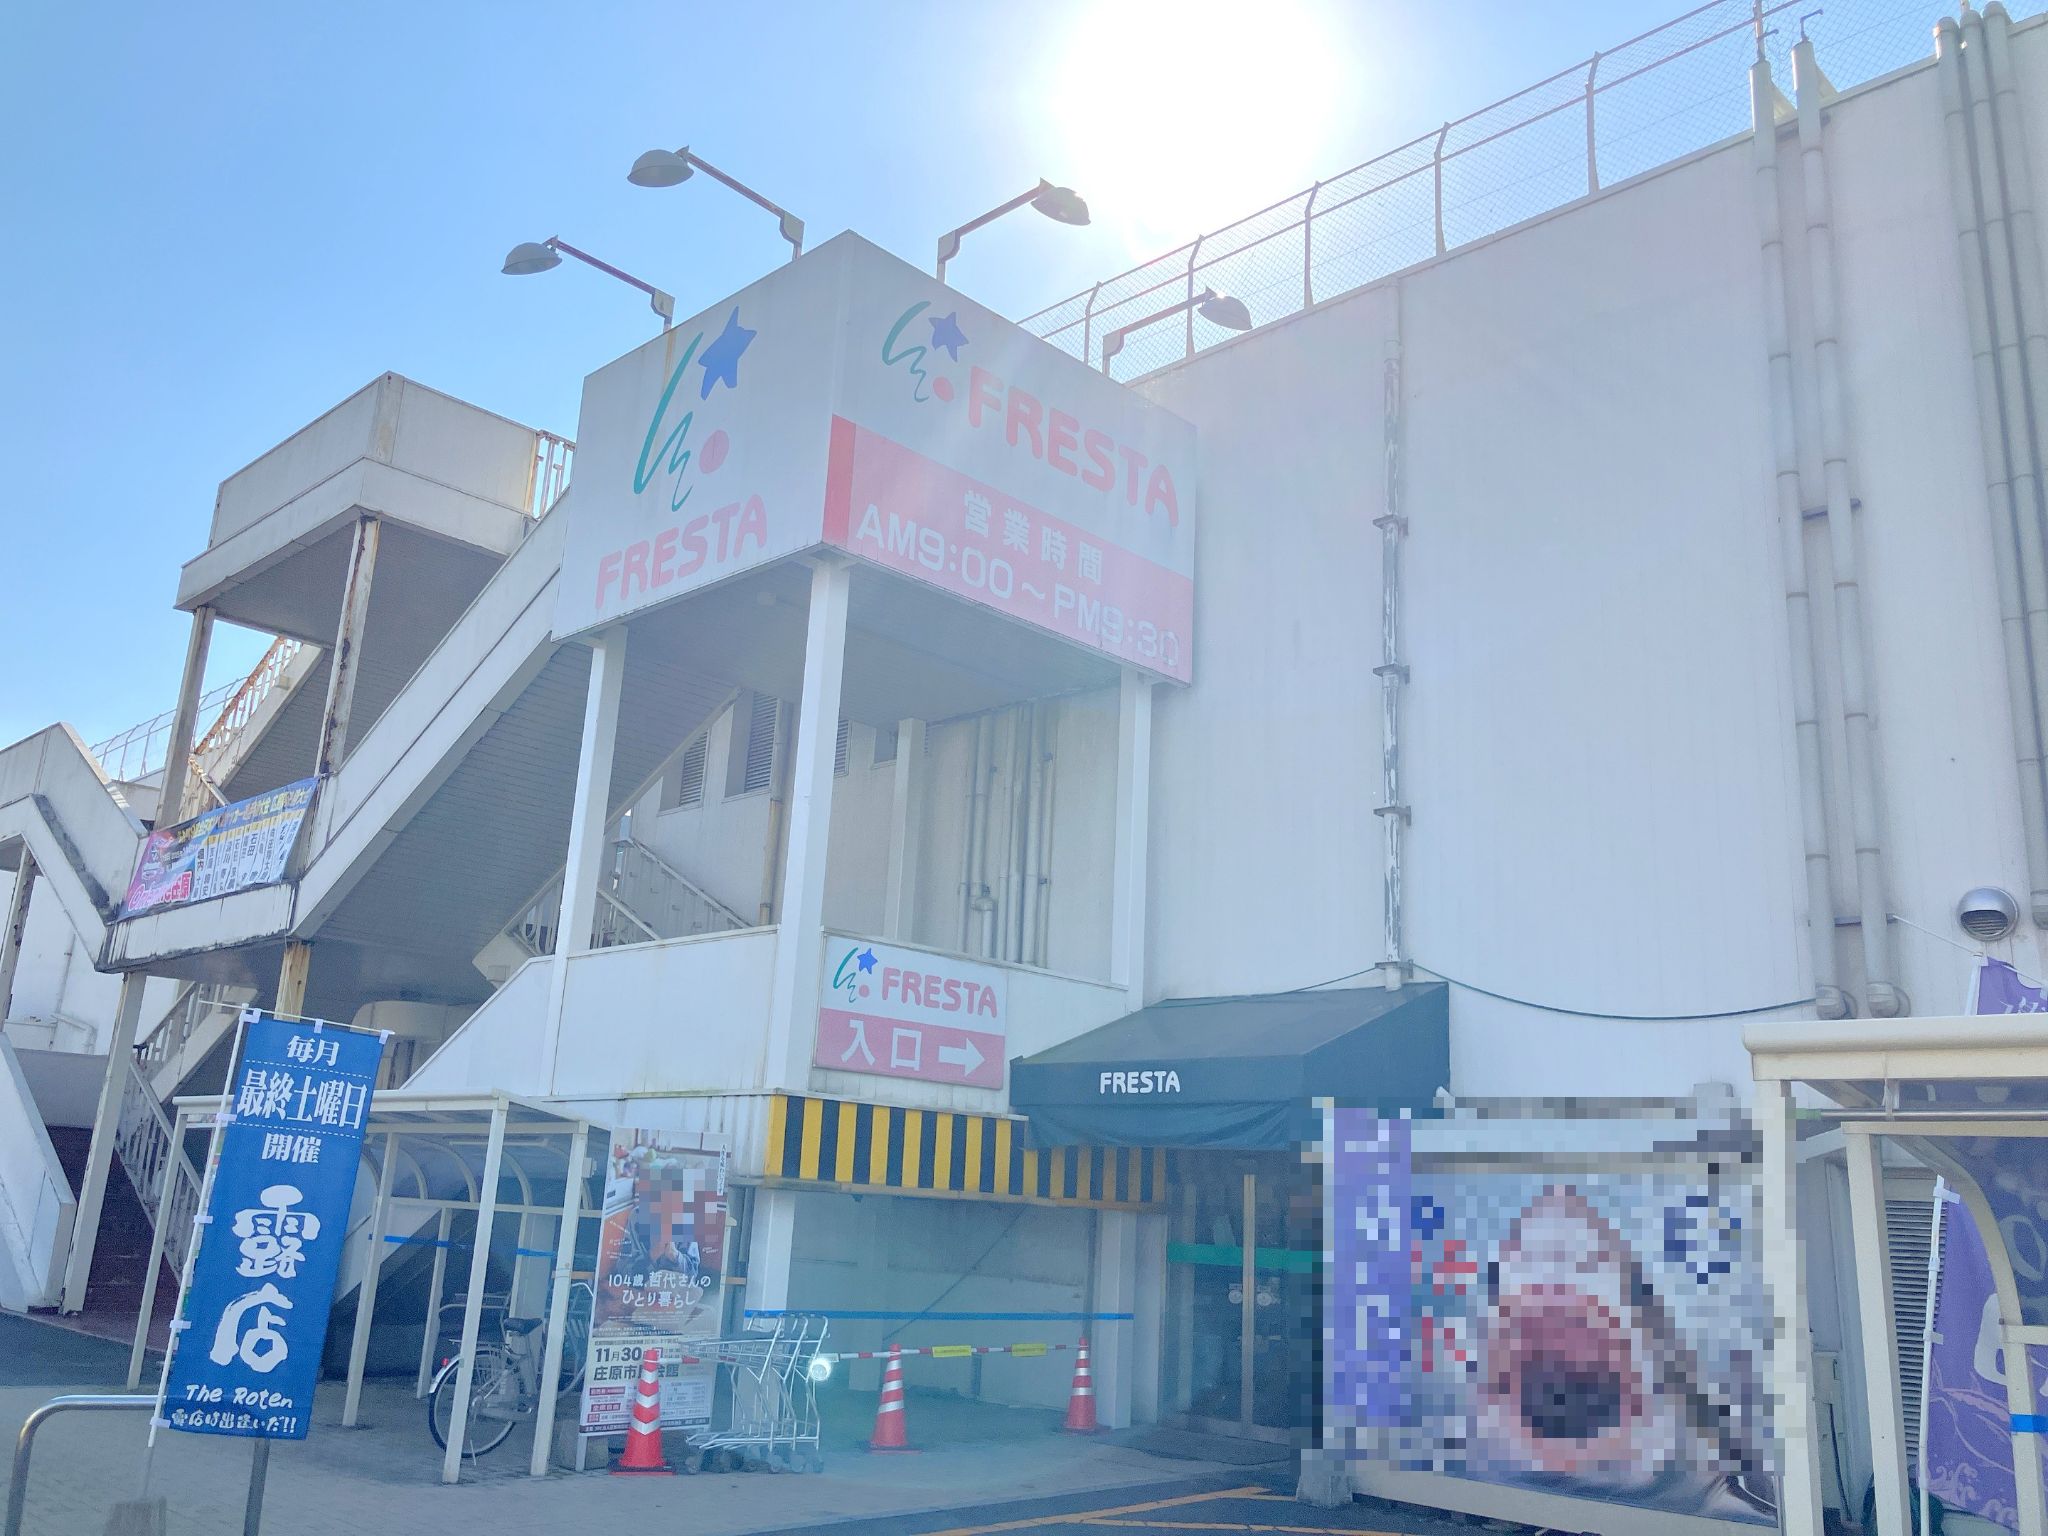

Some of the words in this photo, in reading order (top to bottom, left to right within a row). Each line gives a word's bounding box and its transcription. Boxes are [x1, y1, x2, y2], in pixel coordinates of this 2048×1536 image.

[968, 366, 1179, 528] FRESTA
[596, 494, 767, 609] FRESTA
[963, 490, 1104, 586] 営業時間
[882, 967, 998, 1018] FRESTA
[286, 1034, 340, 1067] 毎月
[840, 1019, 922, 1072] 入口
[236, 1068, 368, 1130] 最終土曜日
[1099, 1070, 1181, 1094] FRESTA
[261, 1132, 322, 1164] 開催
[209, 1184, 321, 1373] 露店
[622, 1290, 696, 1309] ひとり暮らし
[186, 1384, 223, 1403] The
[232, 1386, 293, 1410] Roten
[593, 1364, 680, 1381] 庄原市会館
